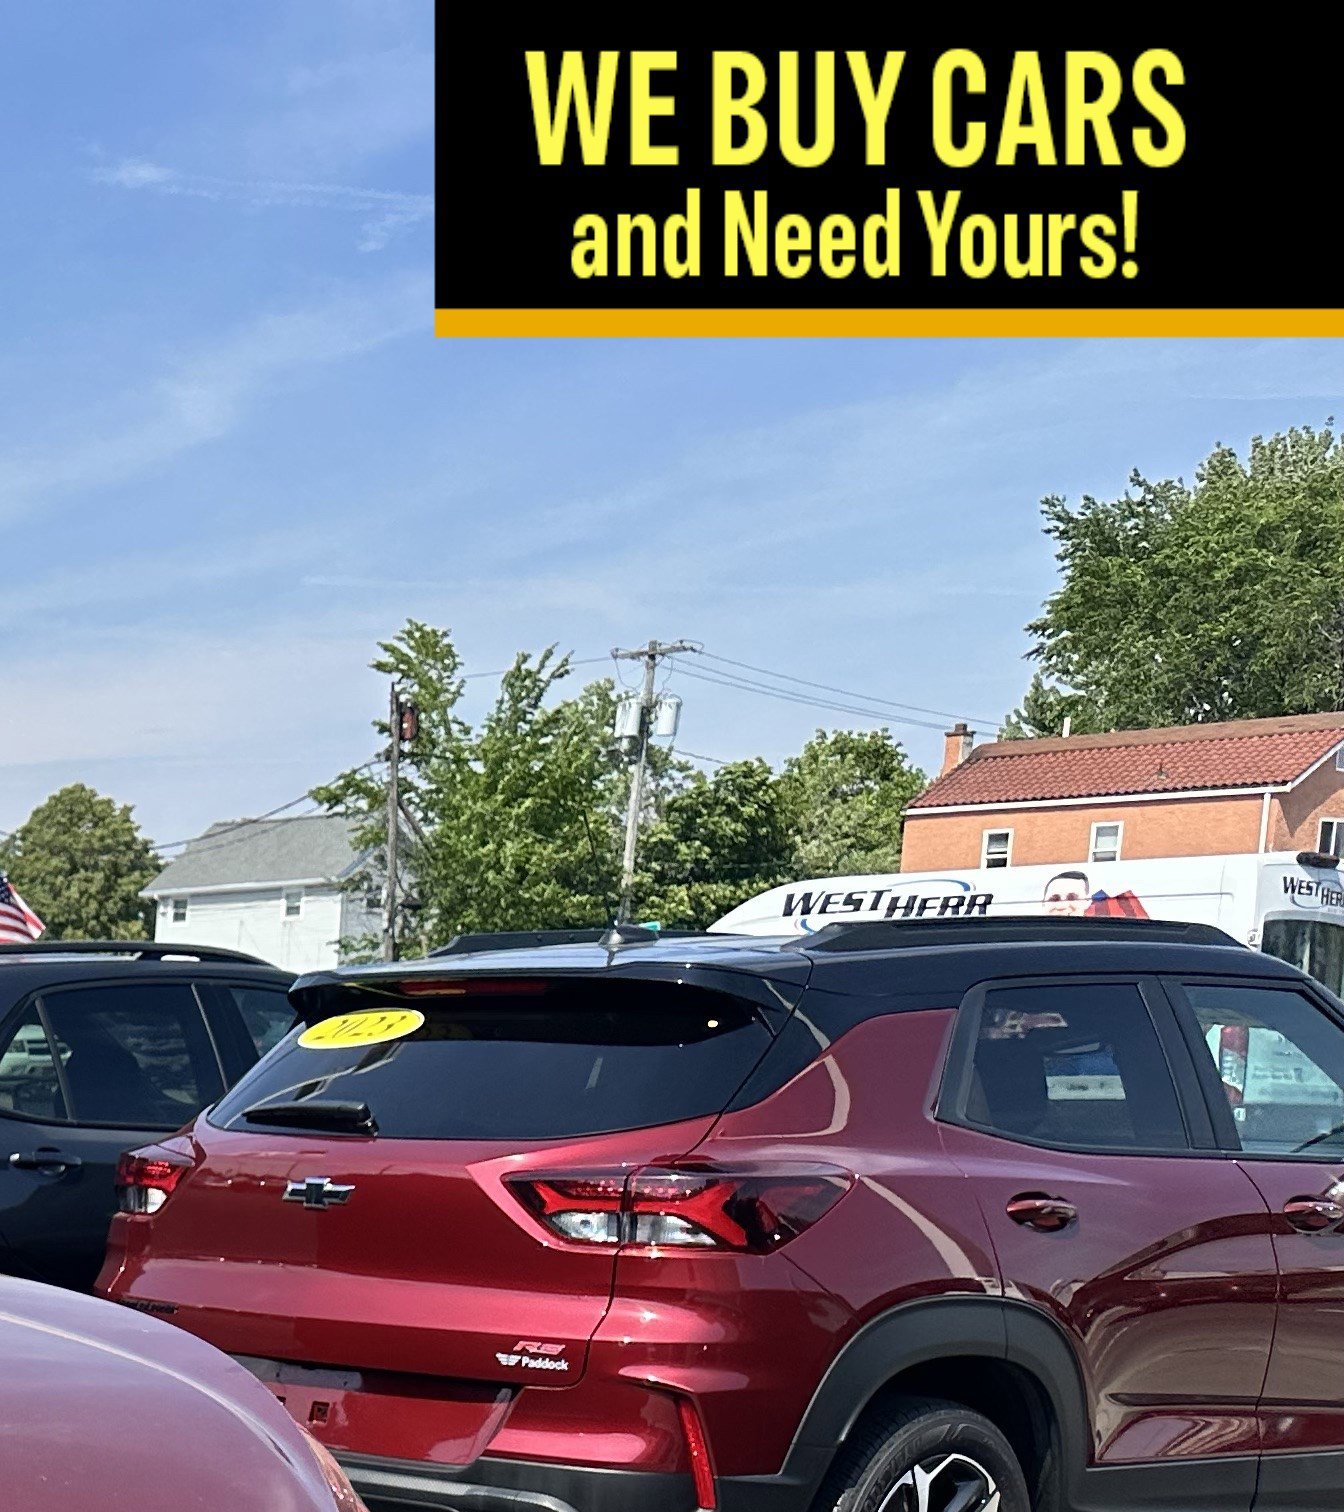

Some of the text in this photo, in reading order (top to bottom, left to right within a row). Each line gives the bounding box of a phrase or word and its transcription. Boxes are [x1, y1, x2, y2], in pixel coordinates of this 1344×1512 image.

[782, 888, 892, 917] WEST
[1283, 876, 1344, 908] WEST HER
[312, 1015, 408, 1041] 2023
[513, 1341, 566, 1355] RS
[521, 1355, 569, 1371] Paddock
